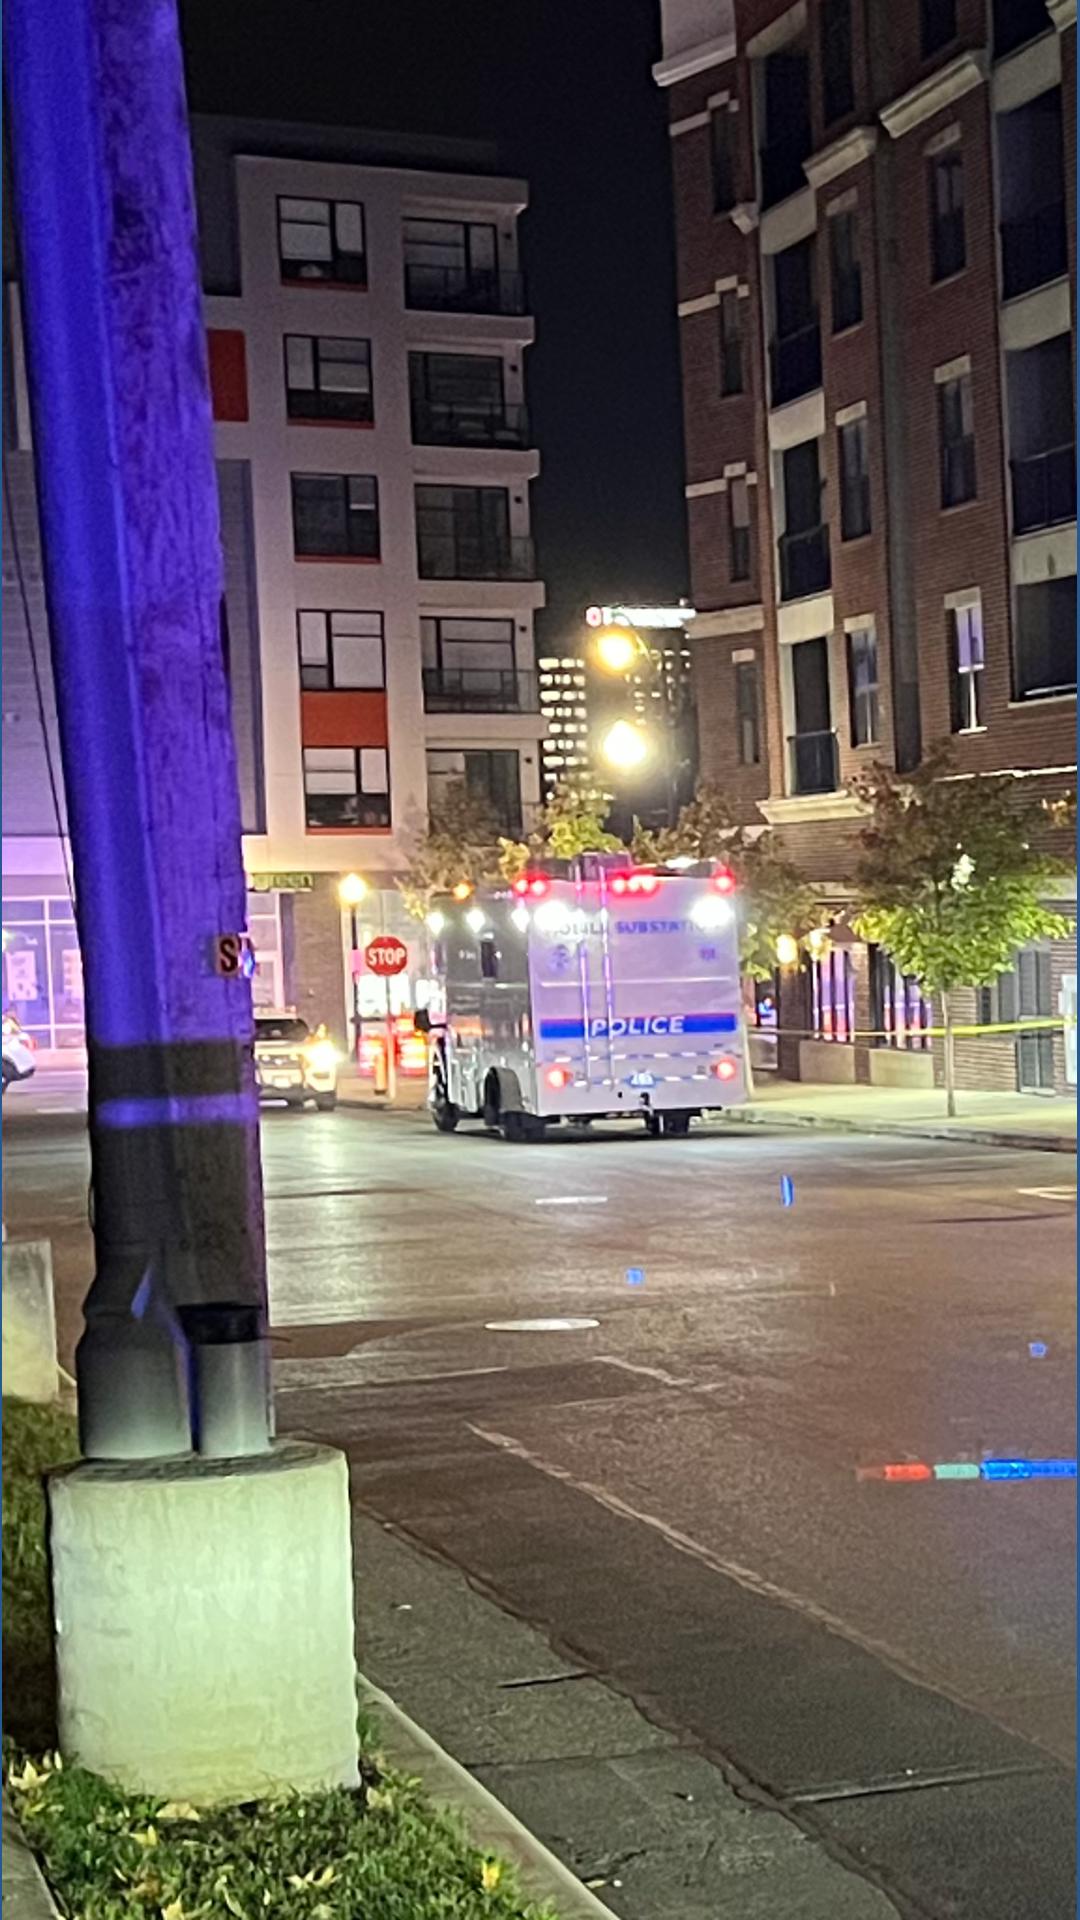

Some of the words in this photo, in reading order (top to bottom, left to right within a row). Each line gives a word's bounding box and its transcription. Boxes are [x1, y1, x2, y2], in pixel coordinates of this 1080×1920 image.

[616, 920, 721, 935] SUBSTATI
[368, 947, 406, 966] STOP
[590, 1015, 685, 1036] POLICE
